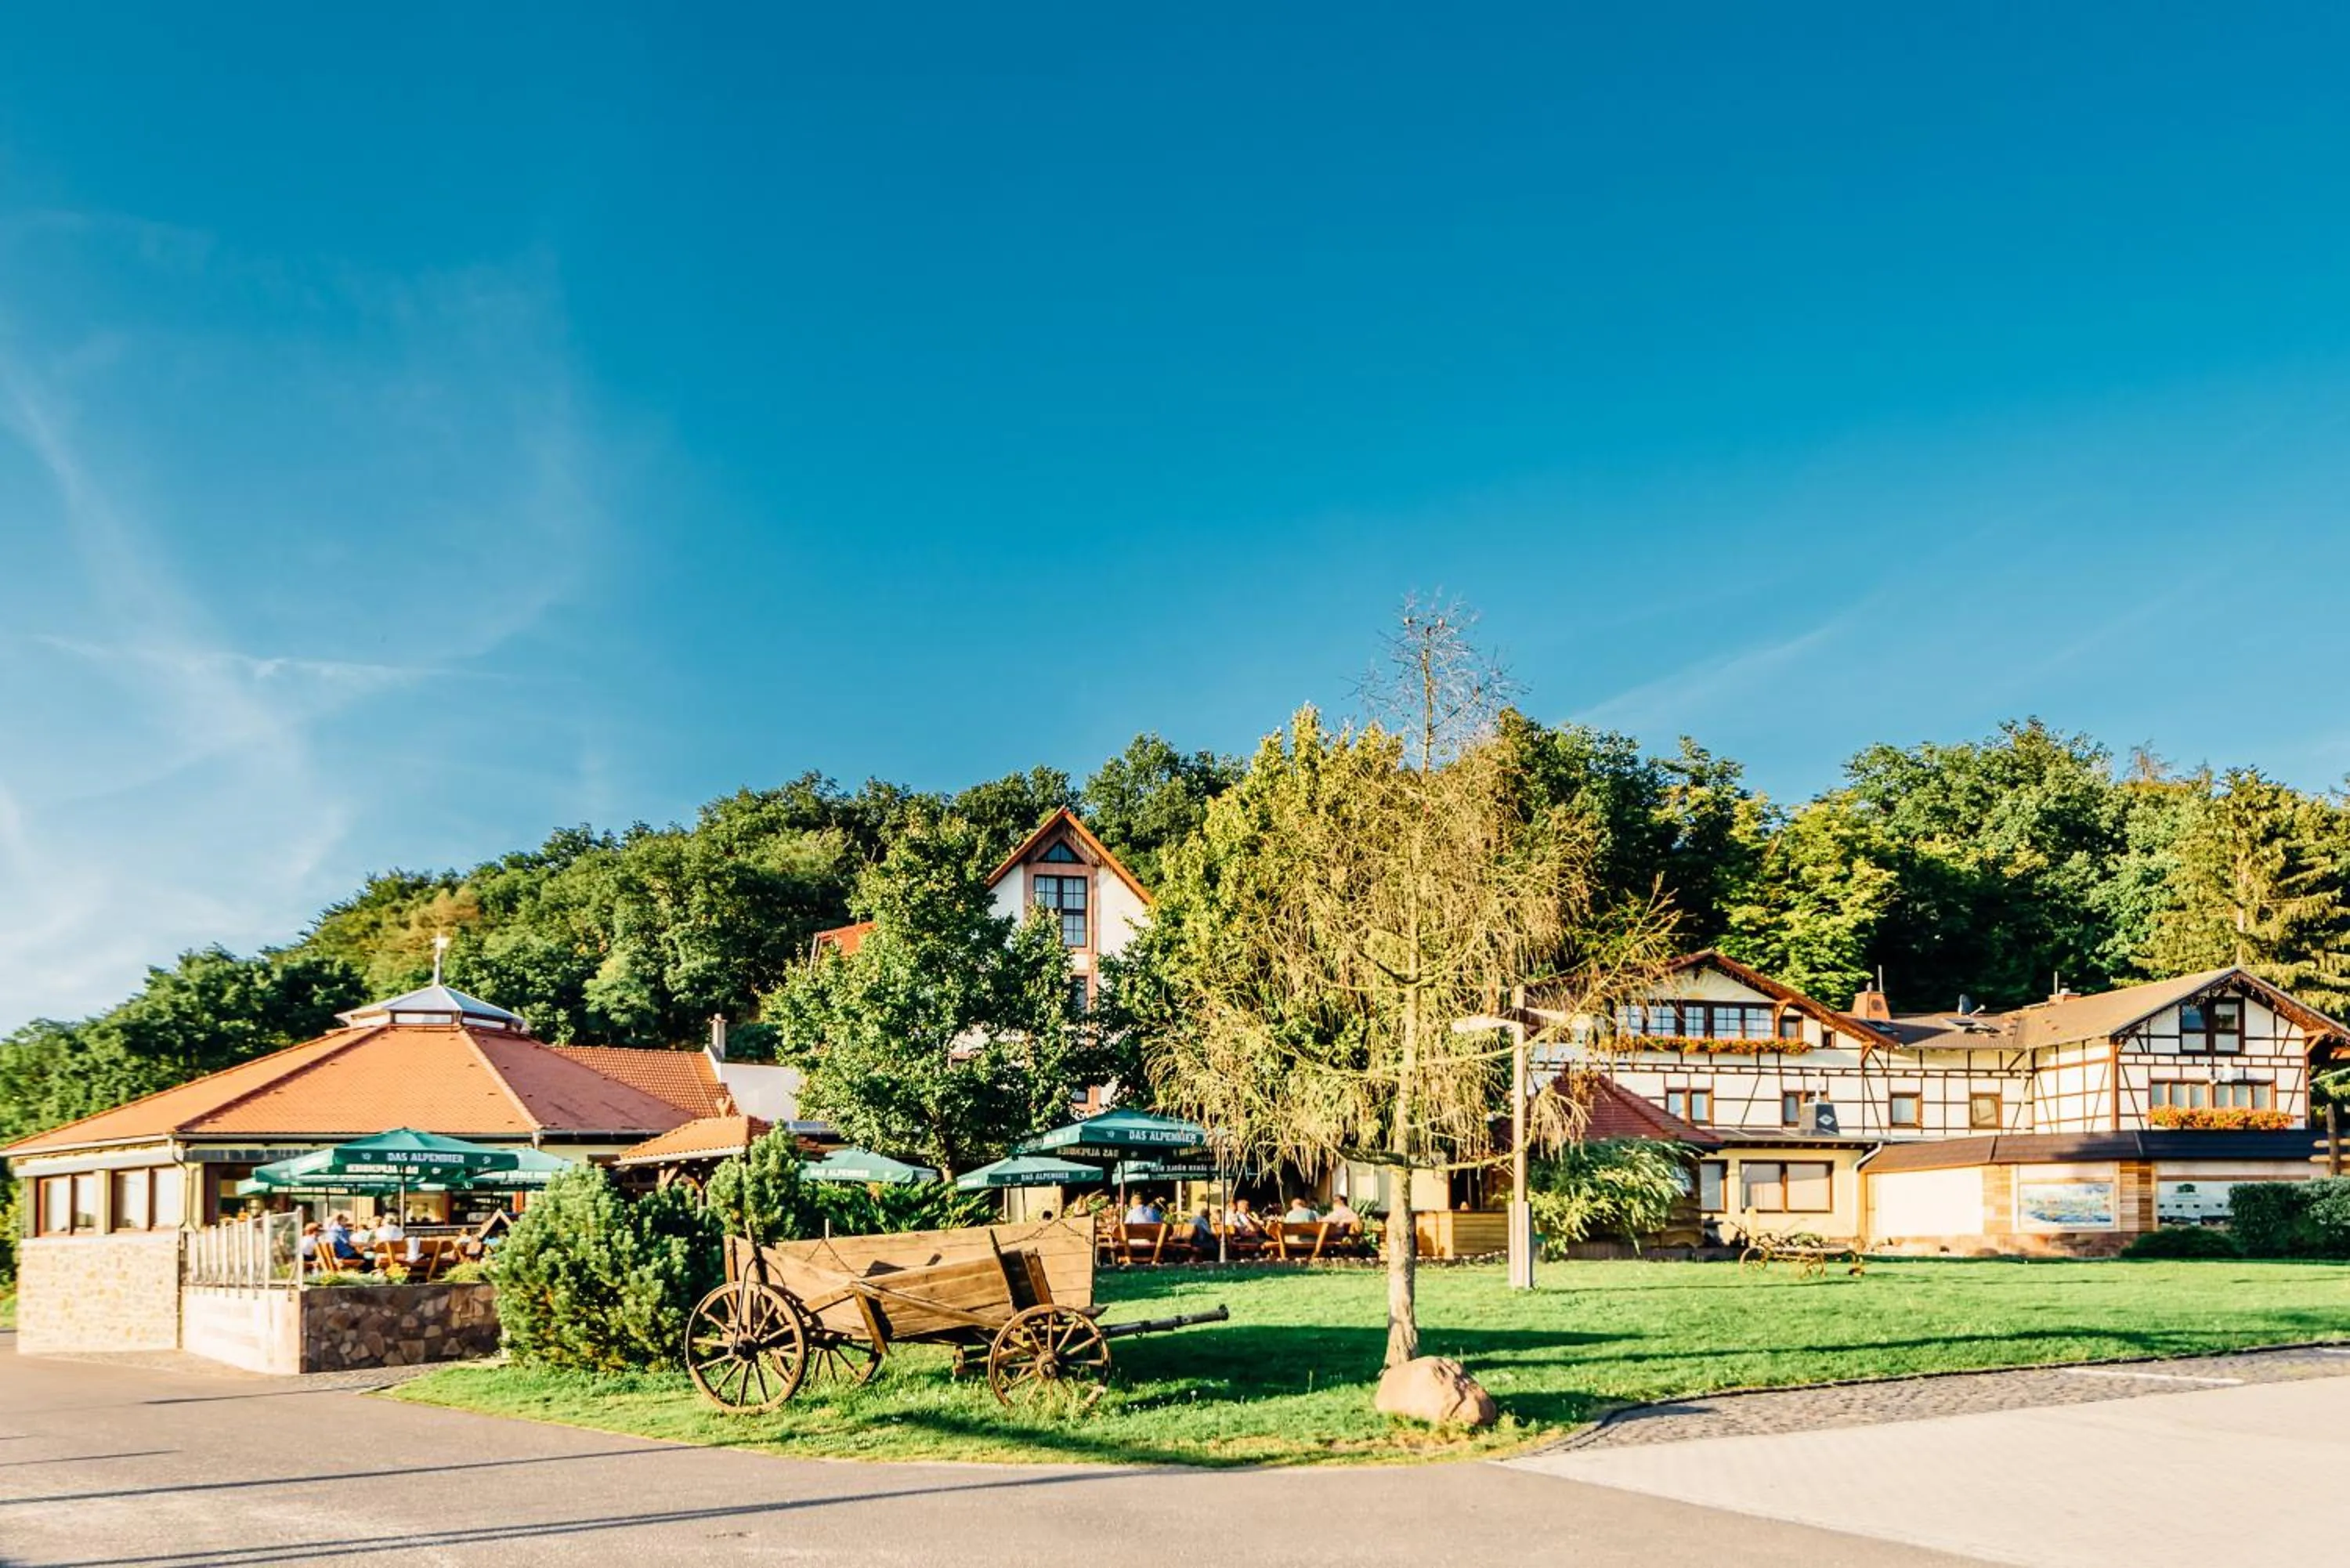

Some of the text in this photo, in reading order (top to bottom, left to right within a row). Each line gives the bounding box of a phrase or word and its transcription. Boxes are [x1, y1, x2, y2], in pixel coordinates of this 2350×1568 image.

[1129, 1130, 1197, 1143] DAS ALPENBIER
[386, 1152, 465, 1163] DAS ALPENBIER
